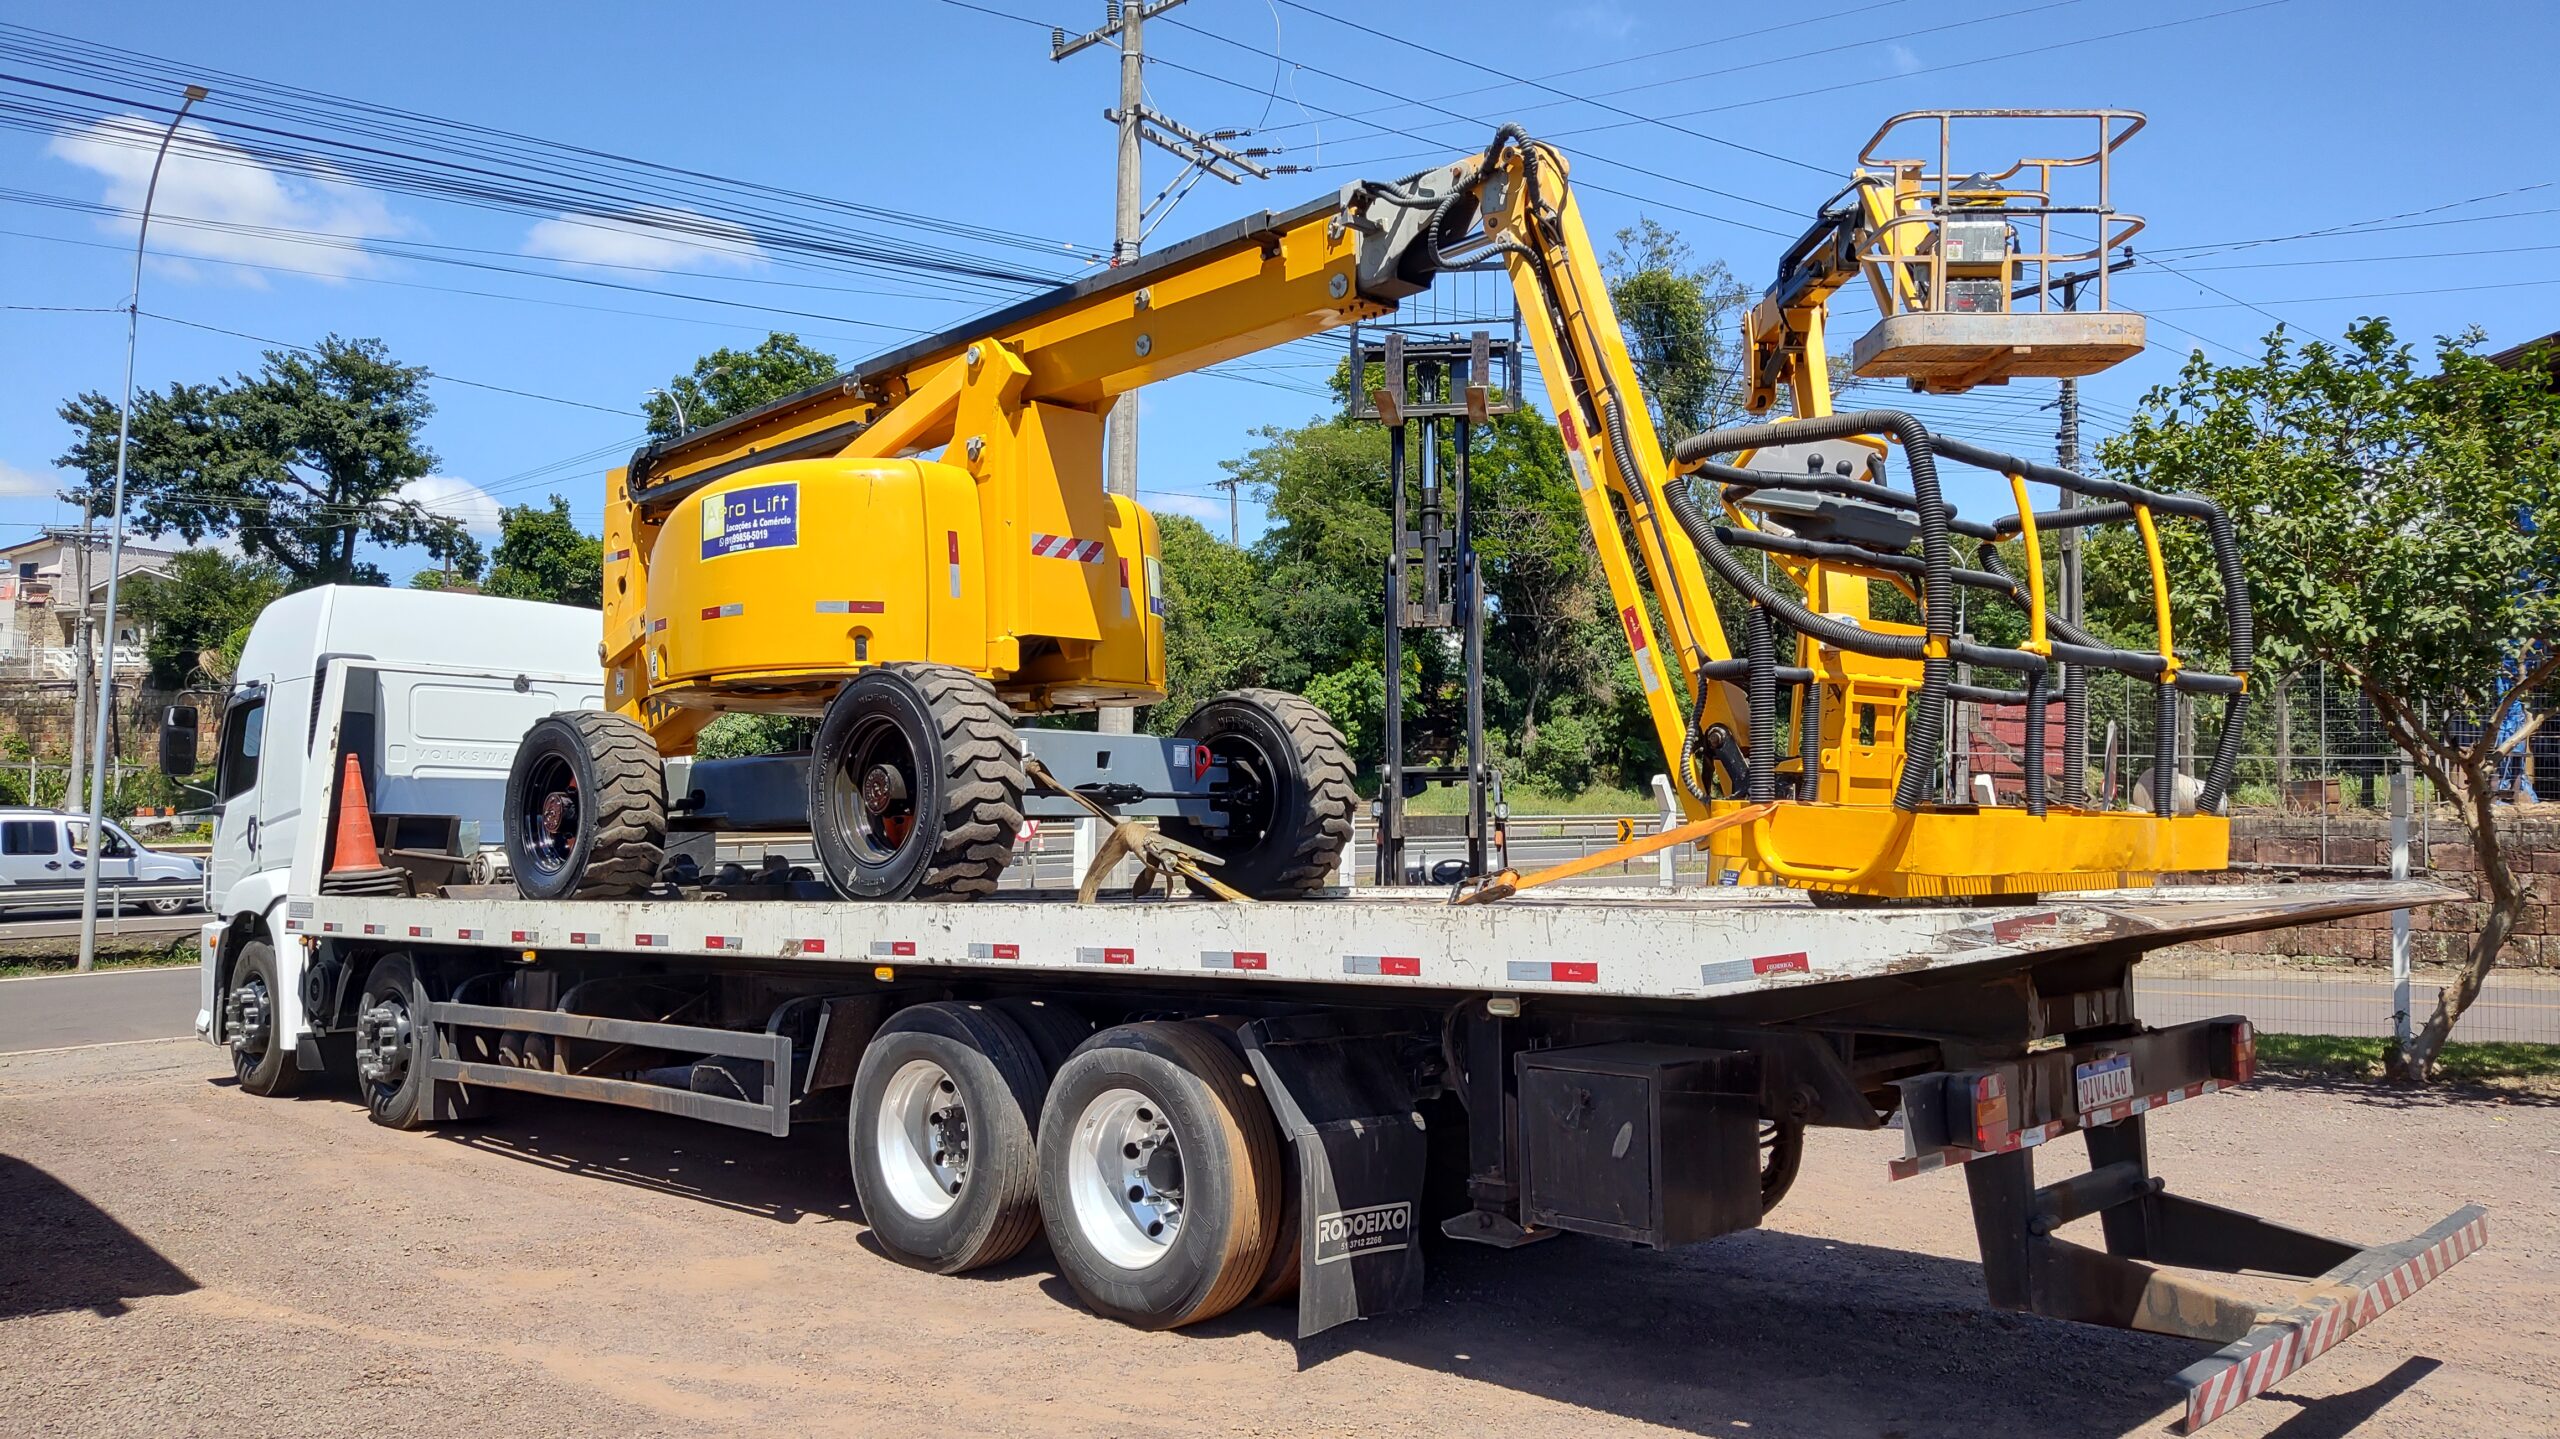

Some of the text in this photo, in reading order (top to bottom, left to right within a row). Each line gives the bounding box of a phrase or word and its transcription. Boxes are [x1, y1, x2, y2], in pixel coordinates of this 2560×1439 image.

[753, 495, 789, 514] Lift
[726, 515, 792, 533] Locações & Comércio
[415, 748, 510, 762] VOLKSWA
[1320, 1208, 1407, 1243] RODOEIXO
[1349, 1238, 1365, 1249] 3712
